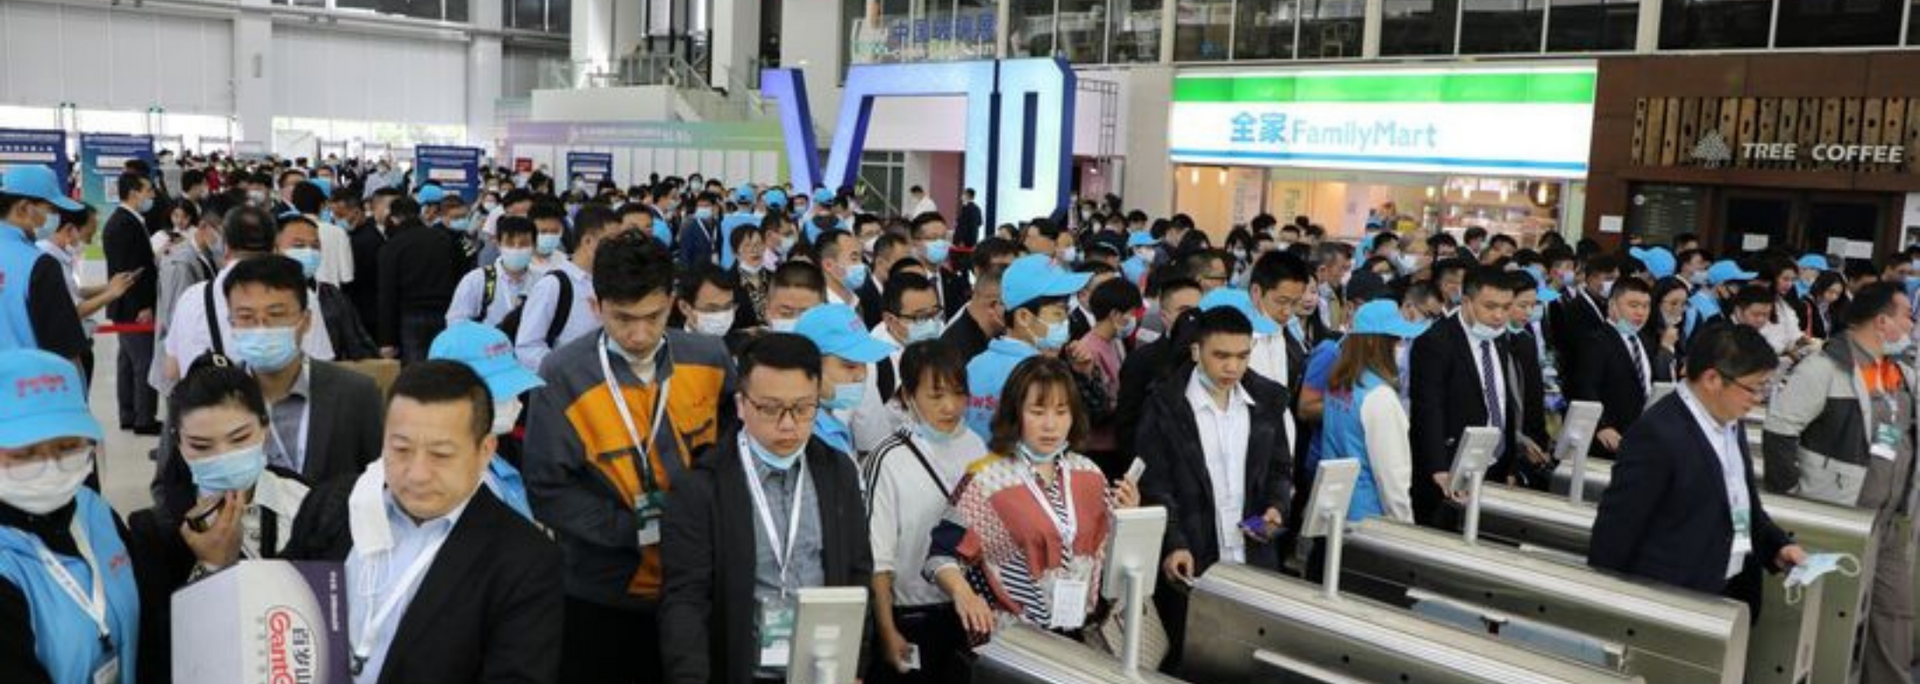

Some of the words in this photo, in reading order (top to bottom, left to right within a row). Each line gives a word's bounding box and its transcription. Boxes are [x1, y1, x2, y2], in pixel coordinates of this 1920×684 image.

[1230, 111, 1288, 143] 全家
[1292, 118, 1438, 152] FamilyMart
[1742, 142, 1798, 161] TREE
[1811, 143, 1905, 164] COFFEE
